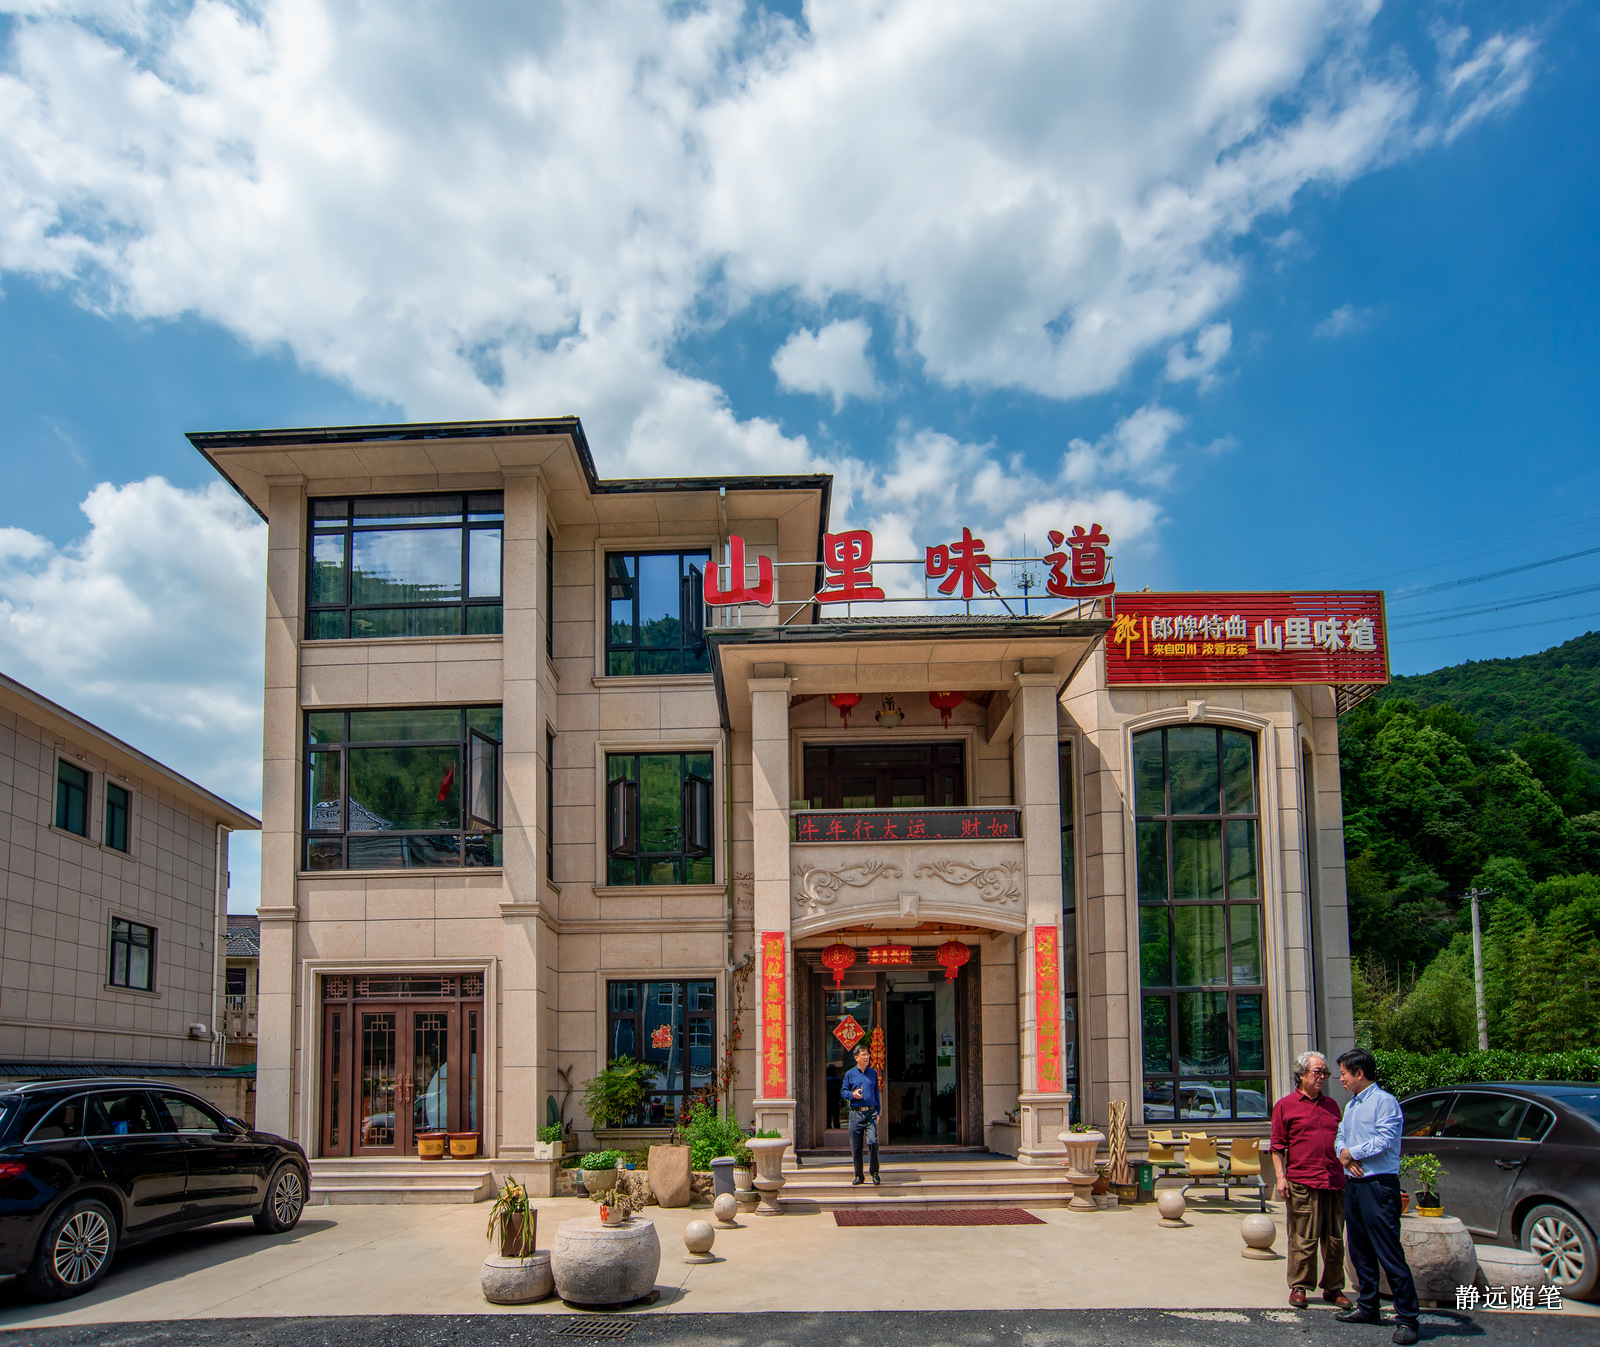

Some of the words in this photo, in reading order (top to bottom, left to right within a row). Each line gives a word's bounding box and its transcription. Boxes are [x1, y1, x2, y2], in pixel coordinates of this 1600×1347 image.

[703, 523, 1115, 608] 山里味道
[1112, 613, 1141, 660] 郎
[1151, 614, 1247, 640] 郎牌特曲
[1255, 617, 1377, 652] 山里味道
[1152, 643, 1197, 657] 来自四川
[1201, 642, 1248, 657] 浓香正宗
[841, 1022, 857, 1040] 福
